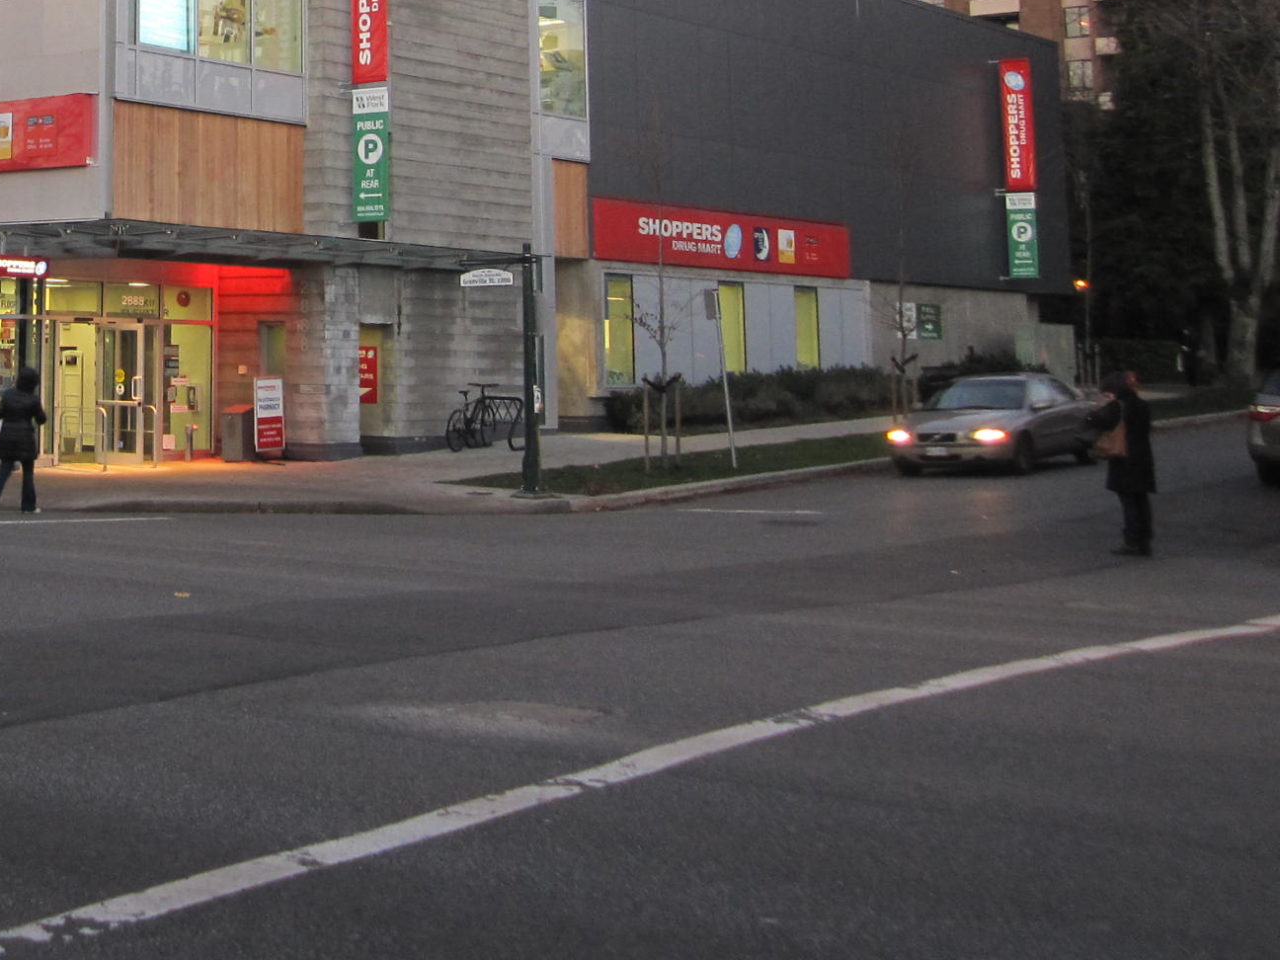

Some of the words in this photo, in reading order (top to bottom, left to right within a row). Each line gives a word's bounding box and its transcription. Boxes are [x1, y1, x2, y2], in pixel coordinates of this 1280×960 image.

[357, 120, 384, 131] PUBLIC
[1006, 93, 1021, 179] SHOPPERS
[1019, 120, 1027, 145] DRUG
[365, 169, 375, 178] AT
[361, 179, 379, 189] REAR
[638, 217, 722, 241] SHOPPERS
[672, 240, 697, 252] DRUG
[698, 243, 722, 254] MART
[122, 295, 145, 306] 2888
